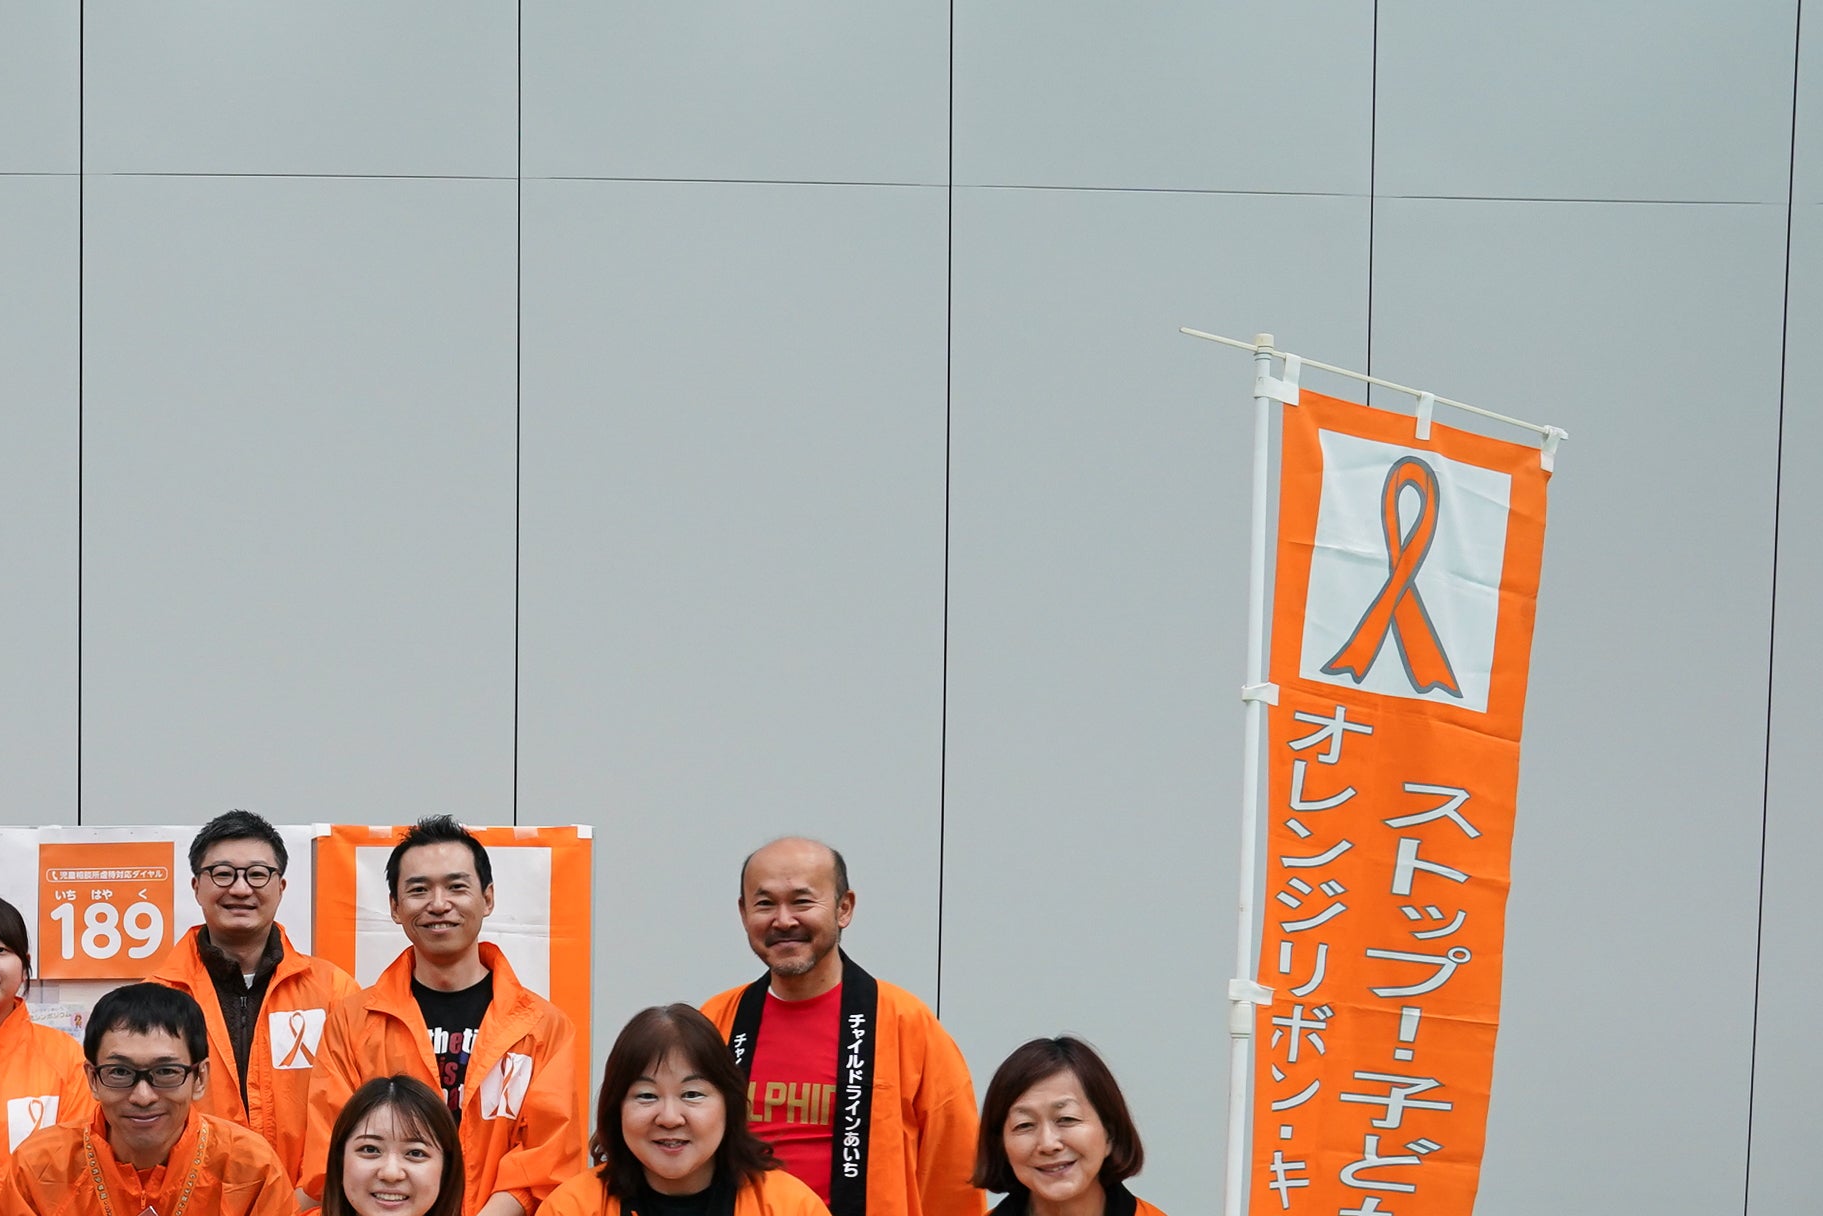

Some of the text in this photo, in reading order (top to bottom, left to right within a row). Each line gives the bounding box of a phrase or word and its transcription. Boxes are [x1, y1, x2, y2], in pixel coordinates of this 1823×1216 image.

[55, 888, 147, 900] いち はや く
[50, 902, 164, 960] 189
[734, 1033, 747, 1064] チャ
[843, 1014, 866, 1178] チャイルドラインあいち
